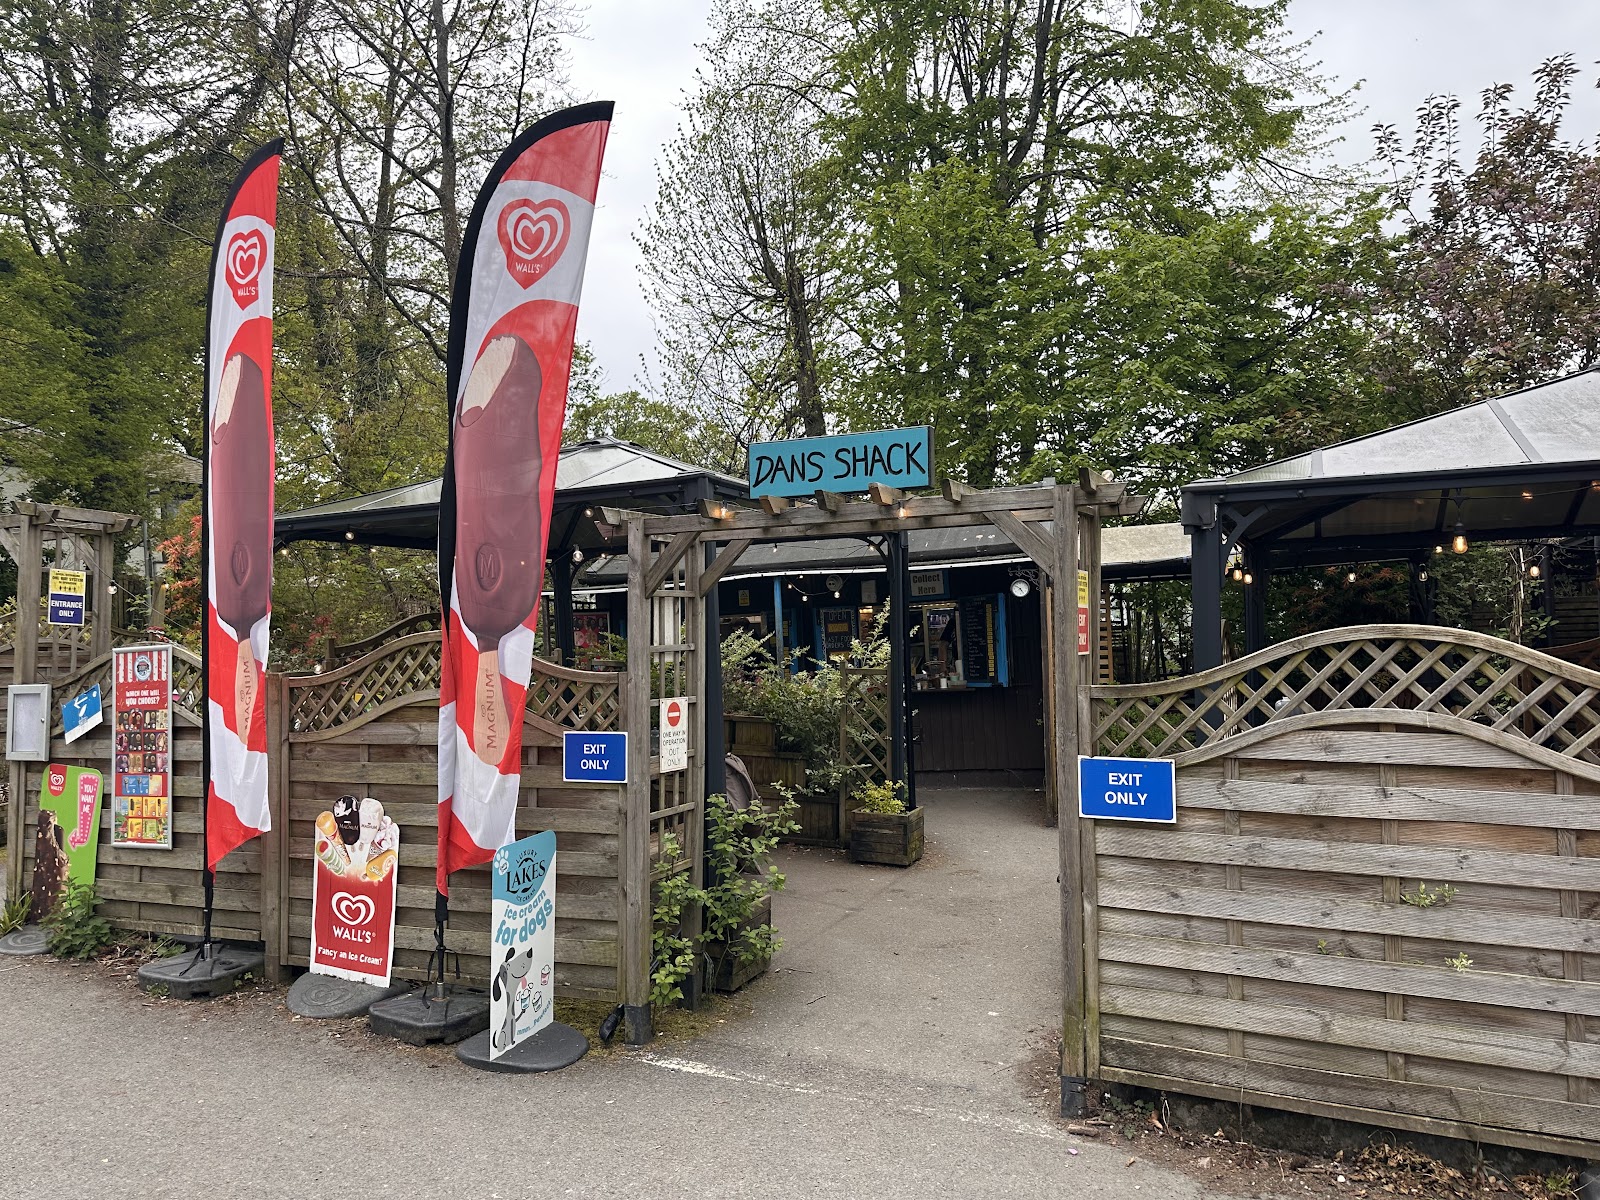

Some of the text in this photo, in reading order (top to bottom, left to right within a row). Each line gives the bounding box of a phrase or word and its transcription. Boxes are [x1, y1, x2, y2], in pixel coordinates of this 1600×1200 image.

[515, 262, 540, 273] WALL'S
[752, 441, 926, 488] DANS SHACK
[912, 574, 940, 584] Collect
[917, 586, 937, 595] Here
[51, 600, 83, 609] ENTRANCE
[58, 610, 75, 618] ONLY
[126, 696, 160, 707] YOU CHOOSE?
[485, 672, 497, 750] MAGNUM
[662, 737, 686, 746] OPERATION
[583, 743, 606, 755] EXIT
[668, 747, 679, 757] OUT
[580, 759, 610, 770] ONLY
[667, 758, 681, 767] ONLY
[1108, 772, 1143, 787] EXIT
[84, 784, 94, 793] YOU
[81, 794, 94, 803] WANT
[1104, 791, 1148, 806] ONLY
[82, 804, 91, 813] ME
[515, 849, 538, 864] LUXURY
[506, 859, 546, 894] LAKES
[503, 889, 547, 920] ice cream
[494, 898, 553, 946] for dogs
[332, 925, 371, 944] WALL'S
[317, 946, 383, 966] Fancy an Ice Cream?
